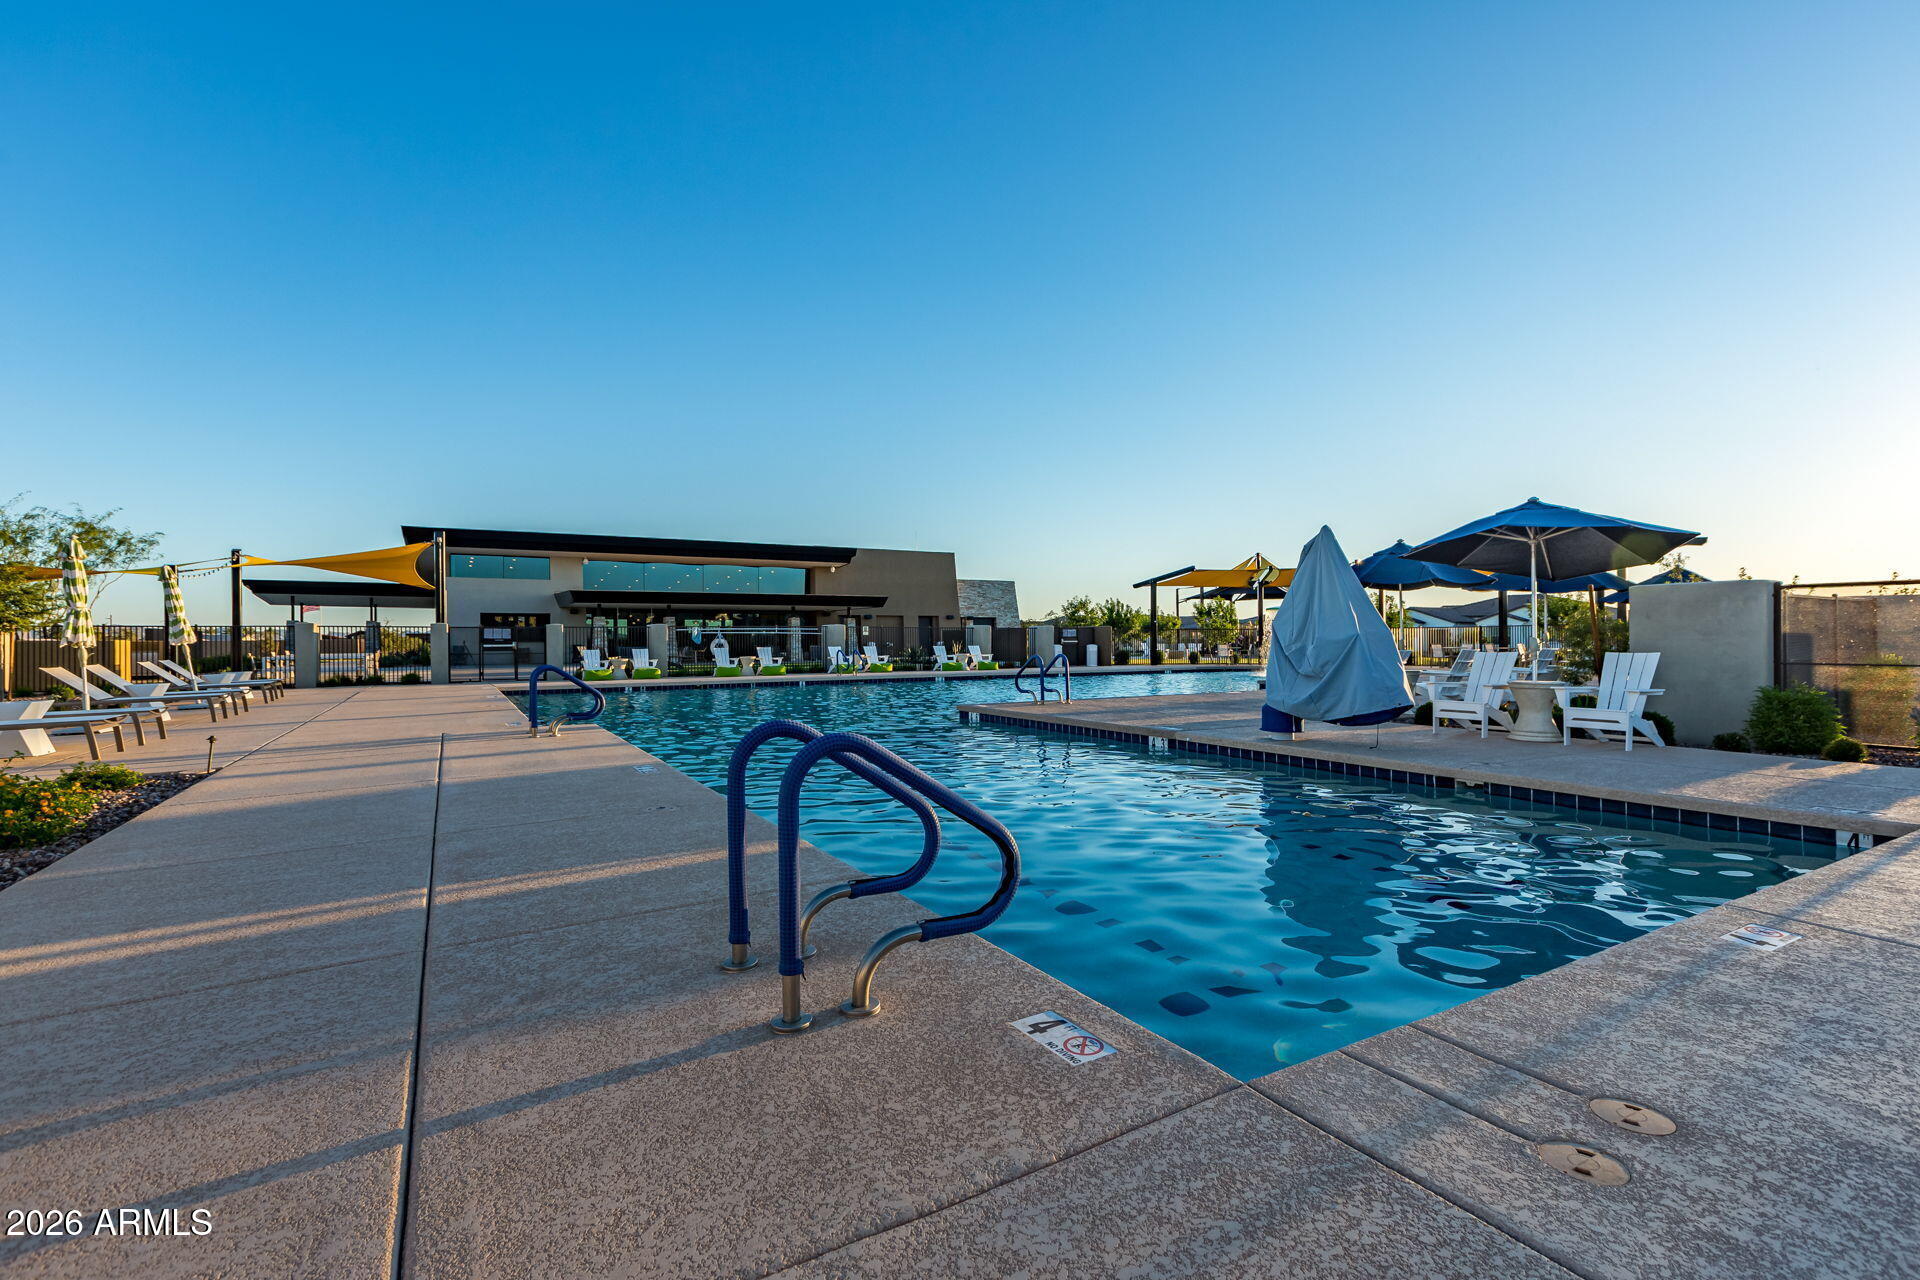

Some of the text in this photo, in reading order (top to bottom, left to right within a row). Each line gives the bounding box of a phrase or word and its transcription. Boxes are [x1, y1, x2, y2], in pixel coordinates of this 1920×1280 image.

[1027, 1019, 1067, 1035] 4
[1046, 1041, 1082, 1064] NO DIVING
